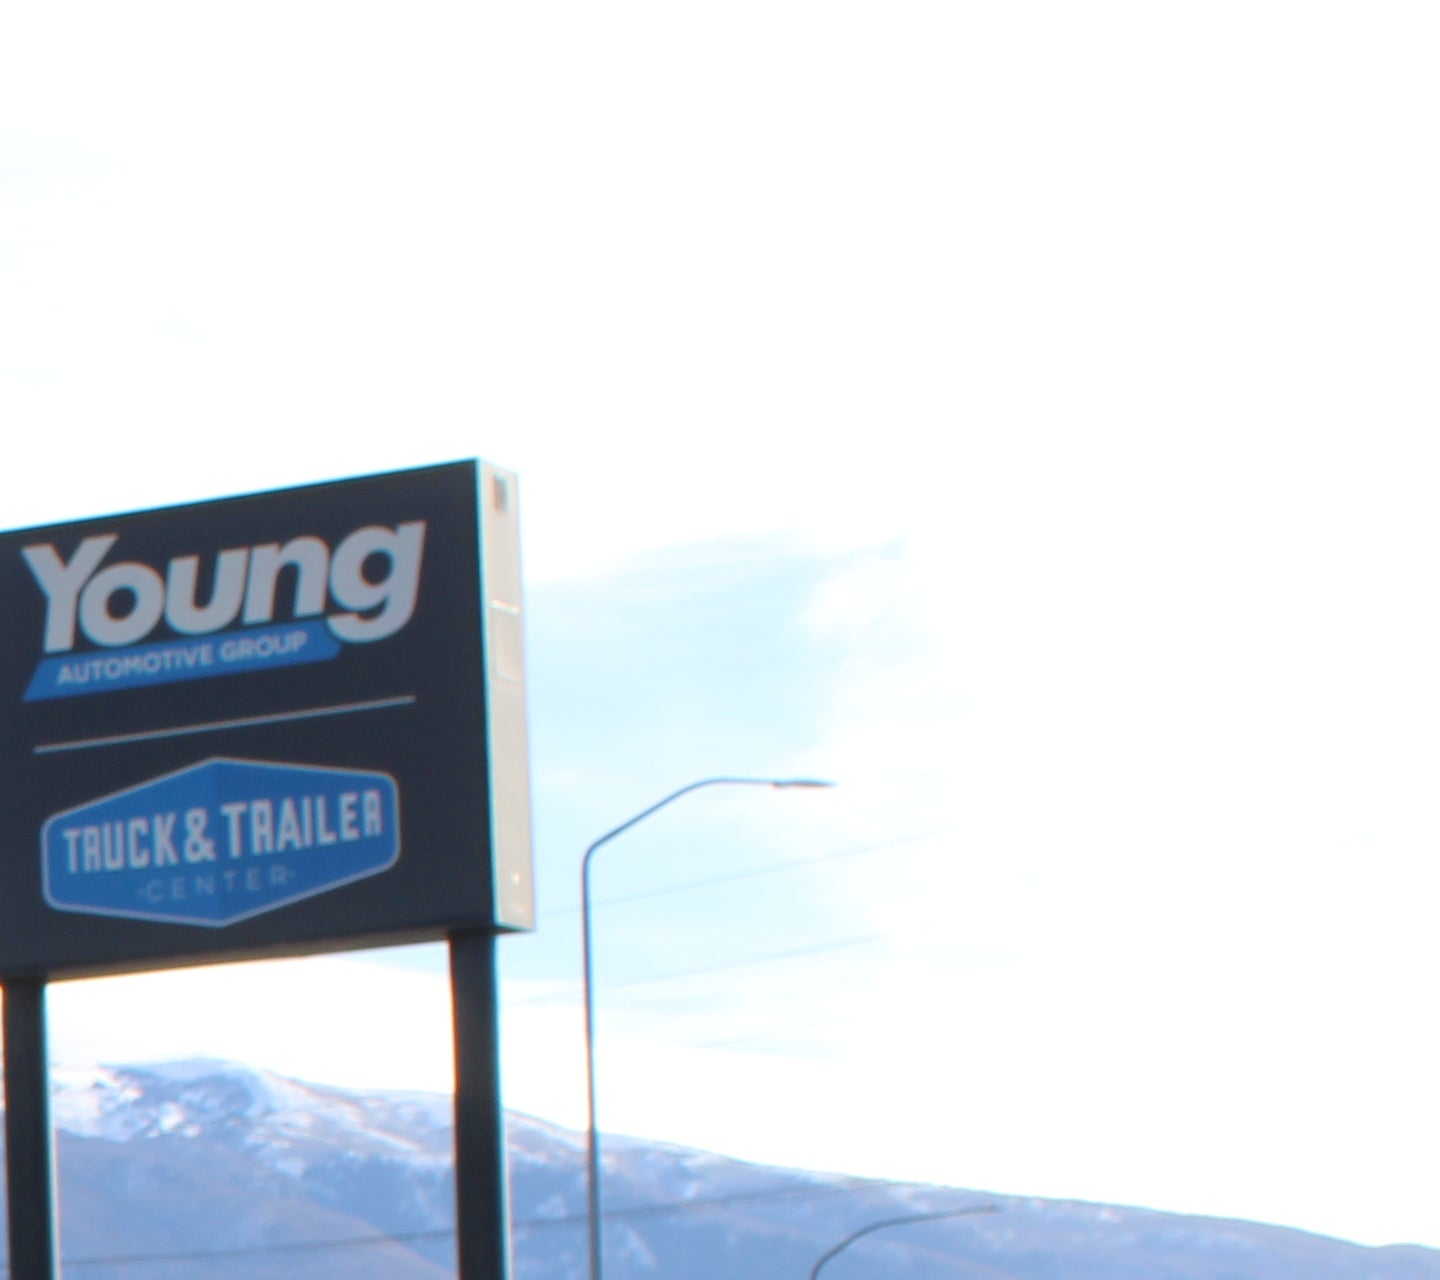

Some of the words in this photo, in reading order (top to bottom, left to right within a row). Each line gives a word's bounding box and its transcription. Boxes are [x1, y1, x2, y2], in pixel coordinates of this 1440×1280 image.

[21, 520, 427, 655] Young
[55, 642, 214, 686] AUTOMOTIVE
[220, 630, 309, 663] GROUP
[61, 812, 179, 875] TRUCK
[219, 788, 383, 859] TRAILER
[145, 865, 287, 902] CENTER
